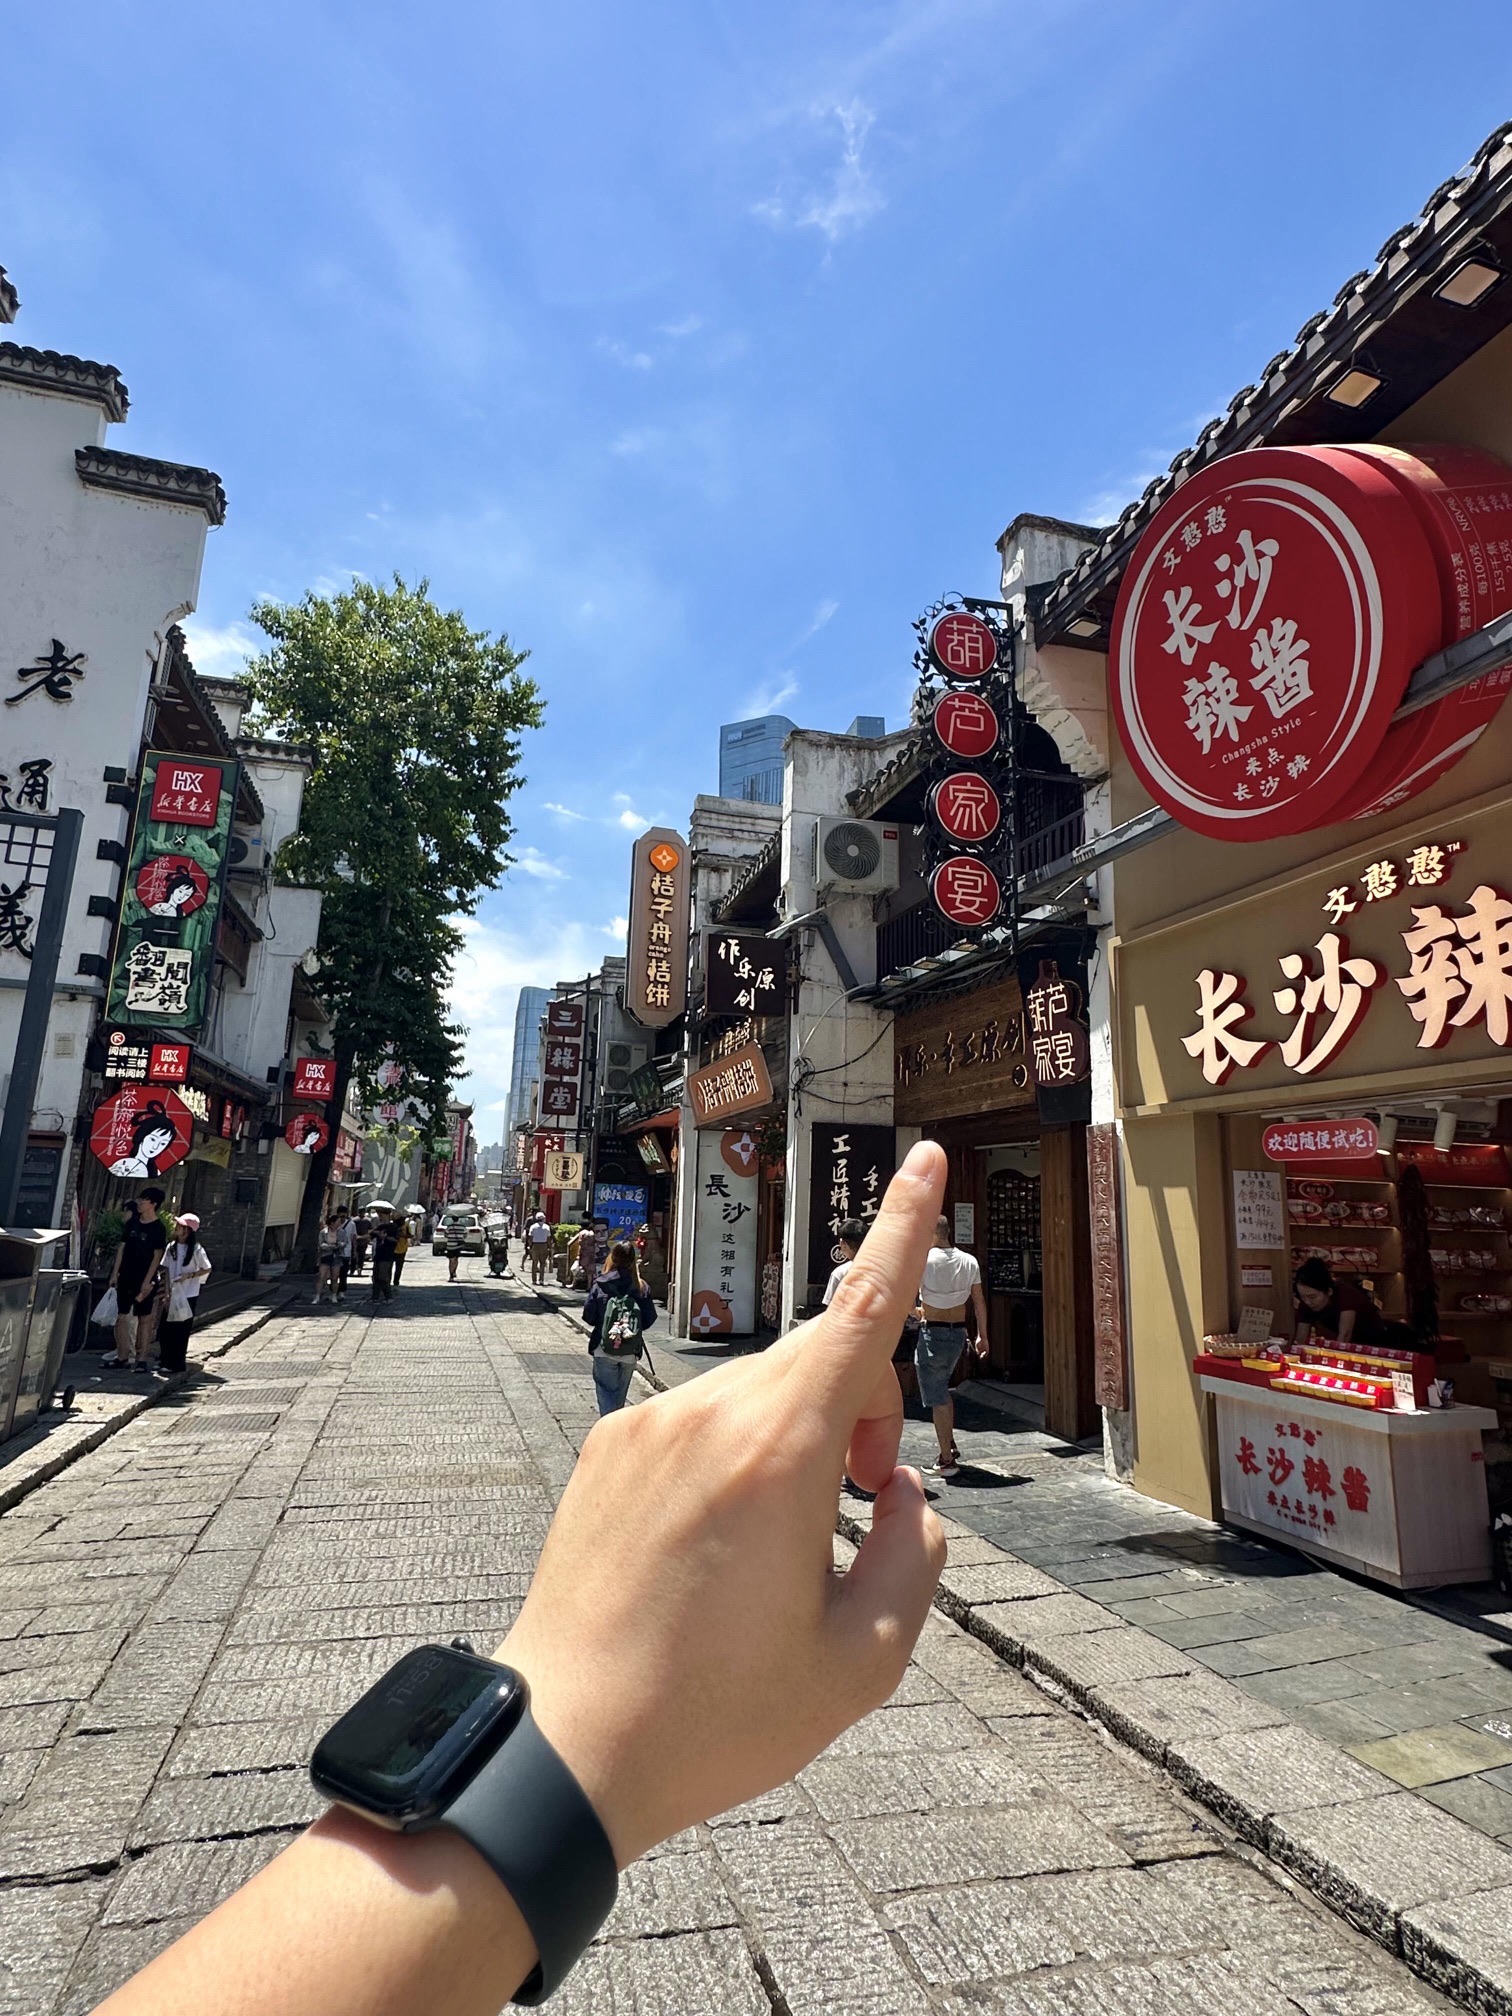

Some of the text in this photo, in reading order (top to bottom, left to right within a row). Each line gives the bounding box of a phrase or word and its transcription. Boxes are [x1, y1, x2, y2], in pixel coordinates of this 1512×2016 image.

[1450, 551, 1472, 632] 营养成分表
[1468, 542, 1488, 596] 每100克
[1161, 529, 1280, 666] 长沙
[1182, 616, 1315, 755] 辣酱
[1222, 717, 1302, 764] Changsha Style
[1246, 748, 1285, 776] 来点
[171, 770, 205, 794] HX
[1232, 754, 1312, 802] 长沙辣
[645, 958, 672, 1007] 桔饼
[1180, 885, 1512, 1087] 长沙辣
[161, 1049, 179, 1063] HX
[305, 1063, 326, 1079] HX
[704, 1173, 752, 1225] 長沙
